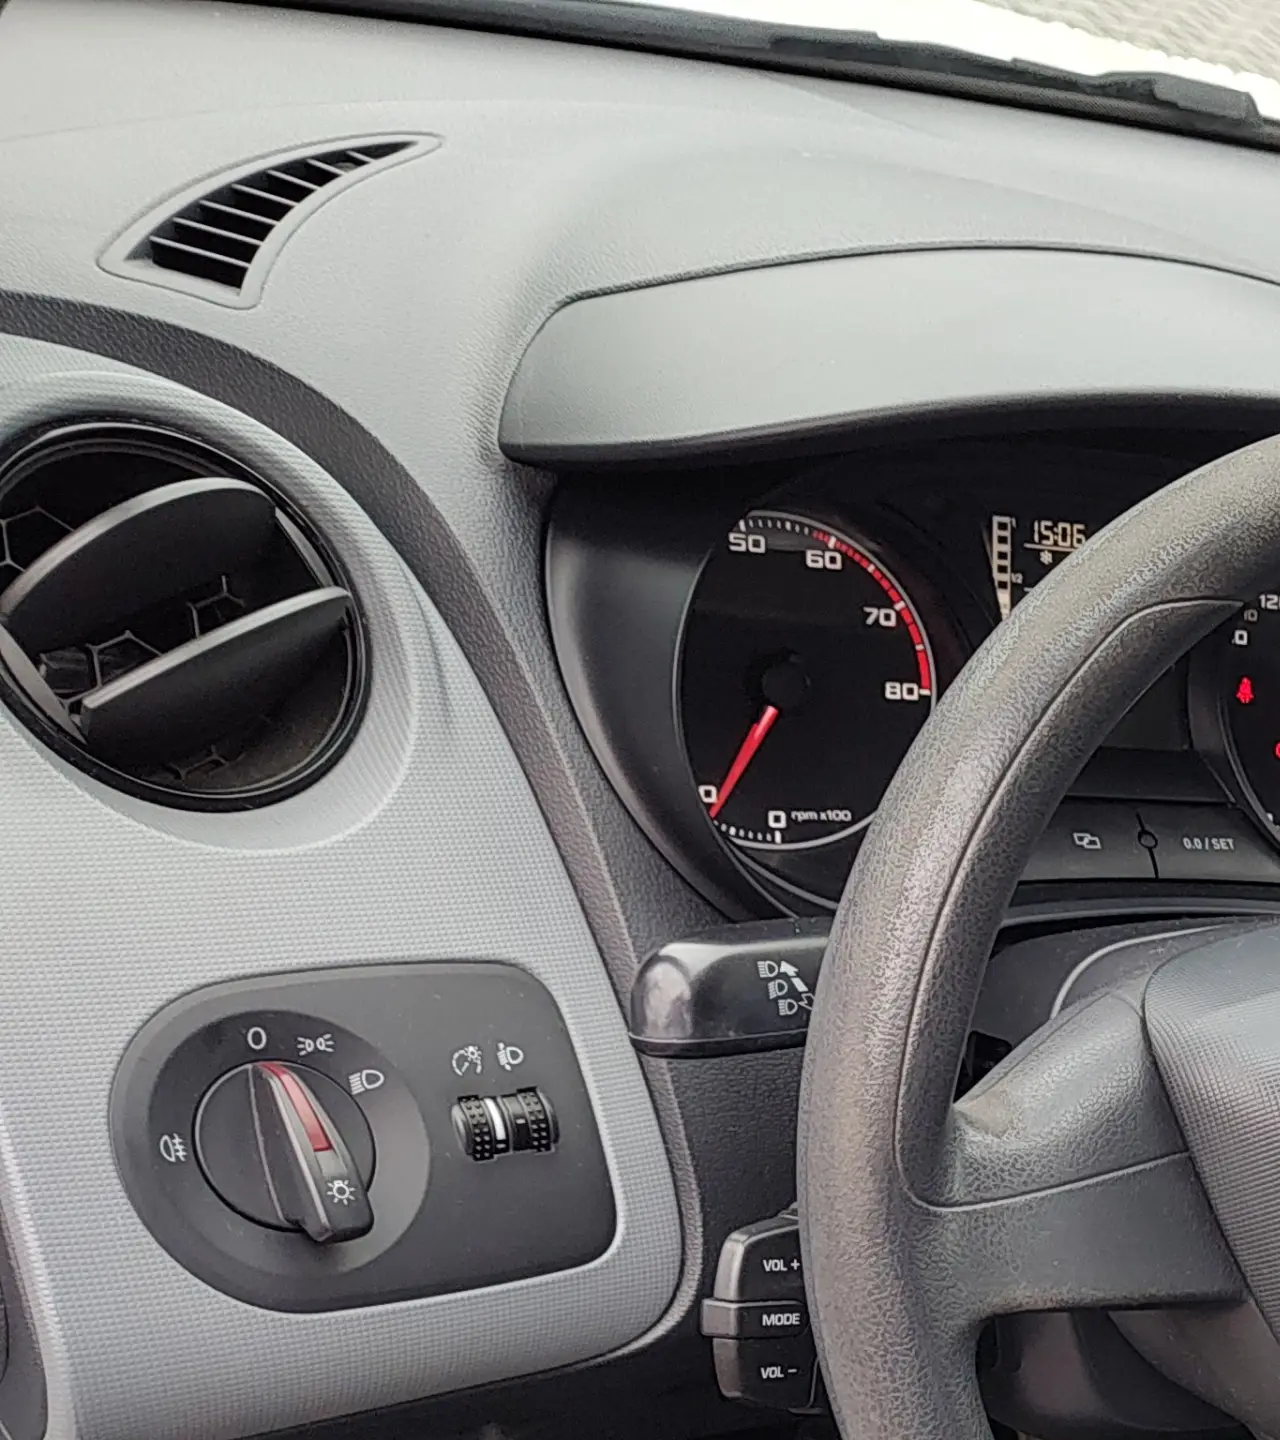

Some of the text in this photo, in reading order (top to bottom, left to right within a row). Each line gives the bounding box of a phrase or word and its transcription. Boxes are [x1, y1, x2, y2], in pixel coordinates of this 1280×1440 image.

[728, 532, 766, 554] 50
[1033, 519, 1086, 548] 15:06
[805, 550, 842, 571] 60
[863, 606, 897, 627] 70
[884, 681, 920, 701] 80
[767, 809, 852, 829] 0 rpm x100
[1182, 837, 1203, 850] 0.0
[1213, 837, 1235, 850] SET
[762, 1259, 788, 1272] VOL
[761, 1312, 801, 1327] MODE
[760, 1366, 784, 1379] VOL
